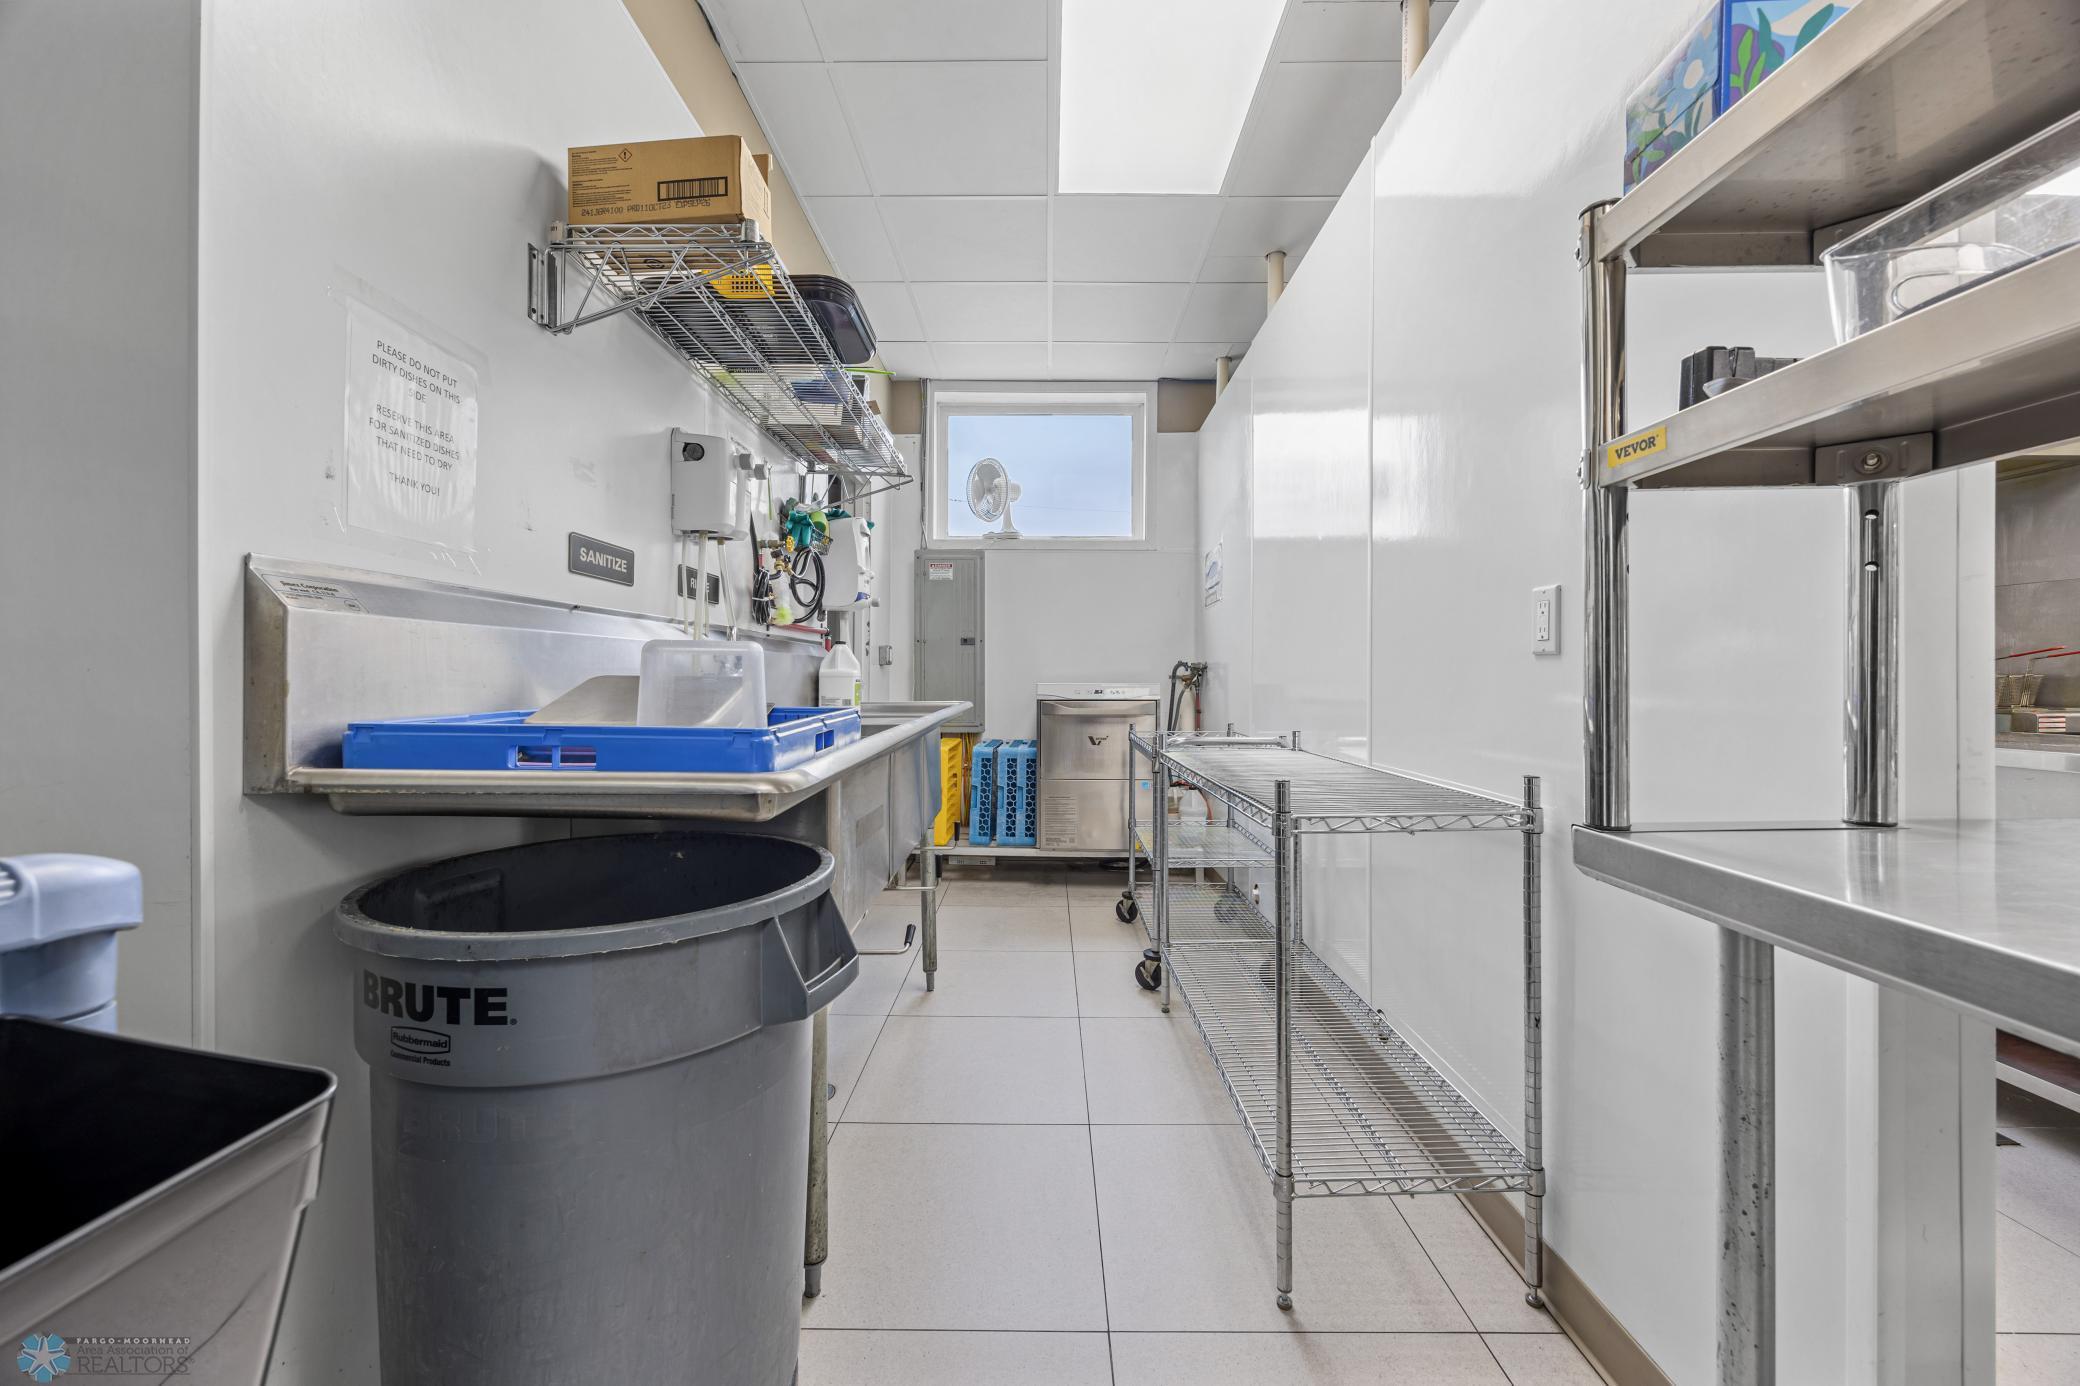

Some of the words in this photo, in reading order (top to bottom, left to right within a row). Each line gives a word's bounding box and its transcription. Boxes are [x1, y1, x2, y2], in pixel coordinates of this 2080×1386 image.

[376, 340, 406, 364] PLEASE
[409, 357, 422, 370] DO
[424, 364, 440, 380] NOT
[442, 374, 458, 388] PUT
[372, 353, 398, 374] DIRTY
[400, 368, 428, 388] DISHES
[430, 382, 442, 396] ON
[444, 389, 460, 404] THIS
[376, 404, 412, 427] RESERVE
[414, 420, 432, 436] THIS
[434, 428, 454, 444] AREA
[369, 417, 386, 432] FOR
[389, 426, 430, 448] SANITIZED
[432, 443, 460, 460] DISHES
[1615, 436, 1656, 460] VEVOR
[376, 436, 398, 452] THAT
[400, 446, 422, 460] NEED
[424, 454, 435, 466] TO
[438, 458, 454, 472] DRY
[388, 472, 418, 489] THANK
[420, 482, 440, 496] YOU!
[580, 547, 627, 573] SANITIZE
[690, 578, 710, 592] RIE
[392, 1031, 448, 1050] Rubbermaid
[423, 1056, 450, 1068] Products
